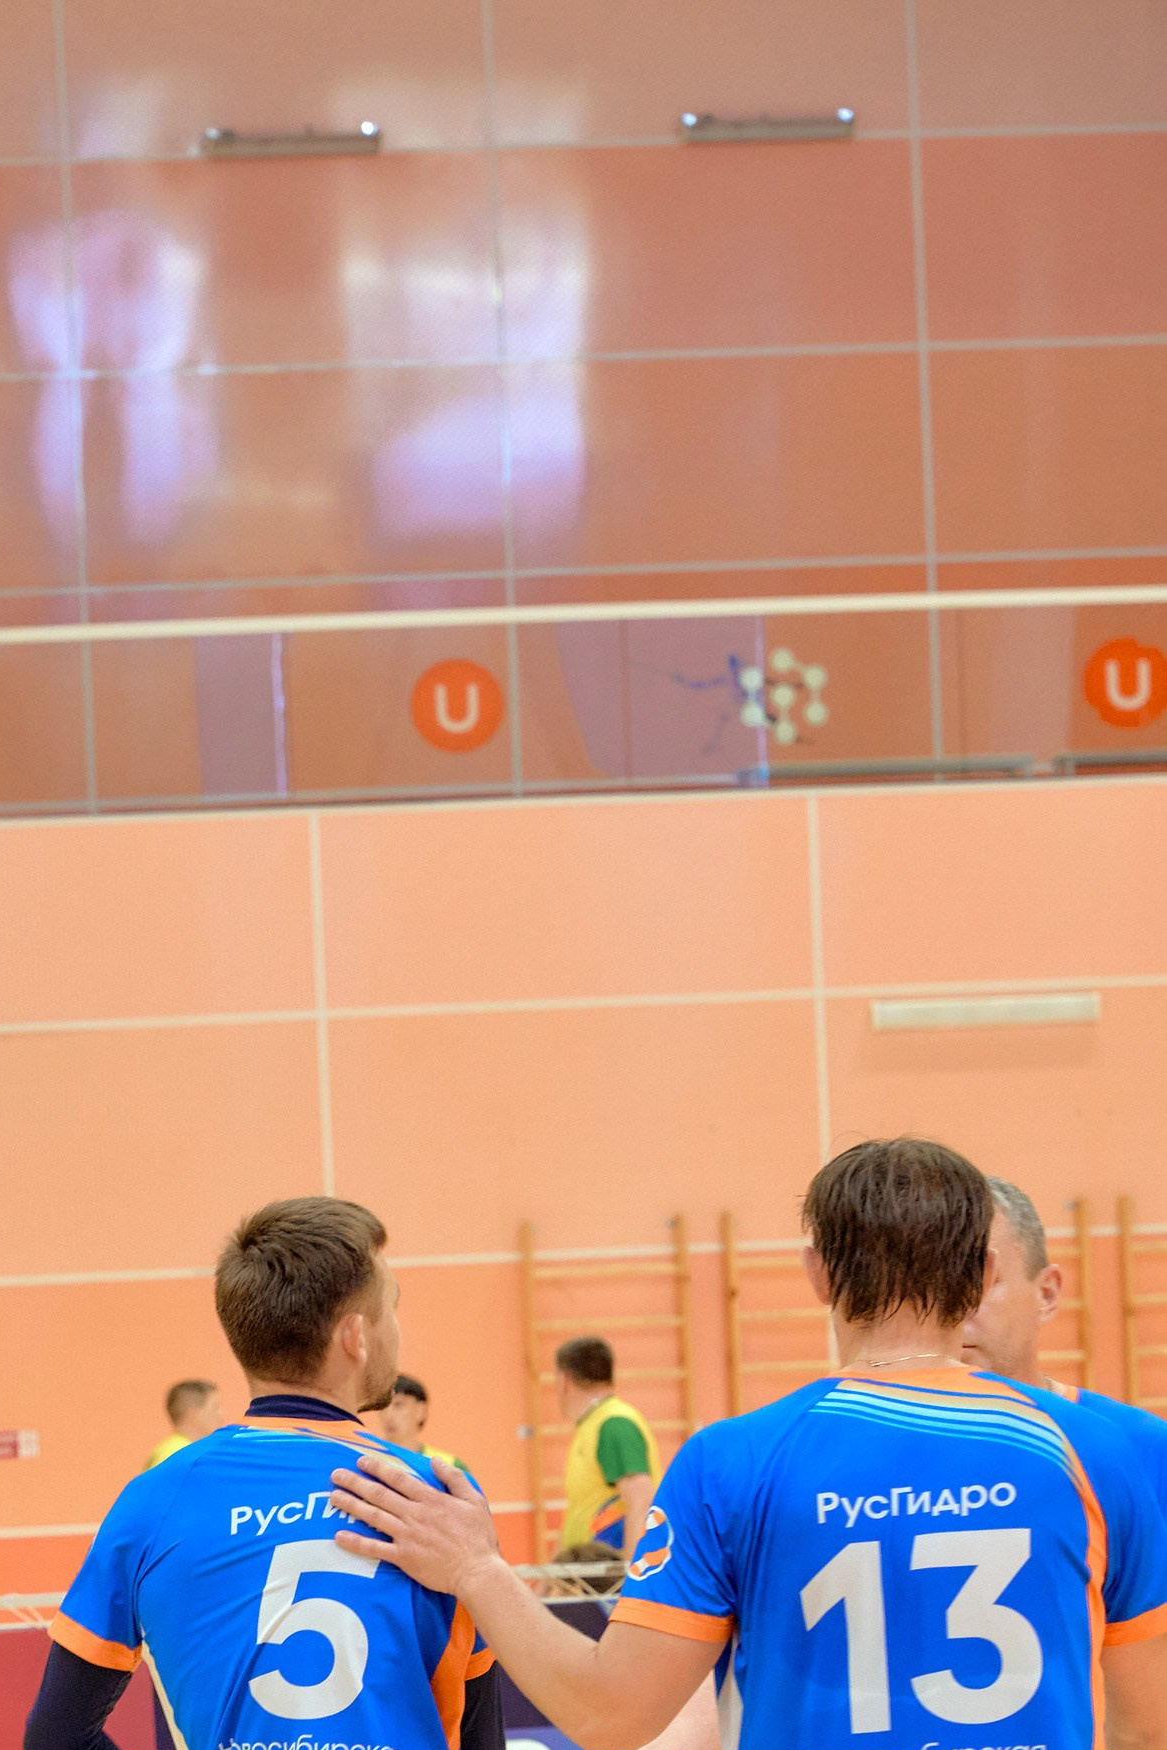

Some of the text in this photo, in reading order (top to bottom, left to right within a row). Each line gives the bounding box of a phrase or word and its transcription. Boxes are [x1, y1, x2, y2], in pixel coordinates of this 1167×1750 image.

[435, 682, 480, 734] U
[1105, 658, 1152, 711] U
[816, 1482, 1017, 1528] РусГидро
[249, 1539, 379, 1720] 5
[800, 1528, 1043, 1734] 13
